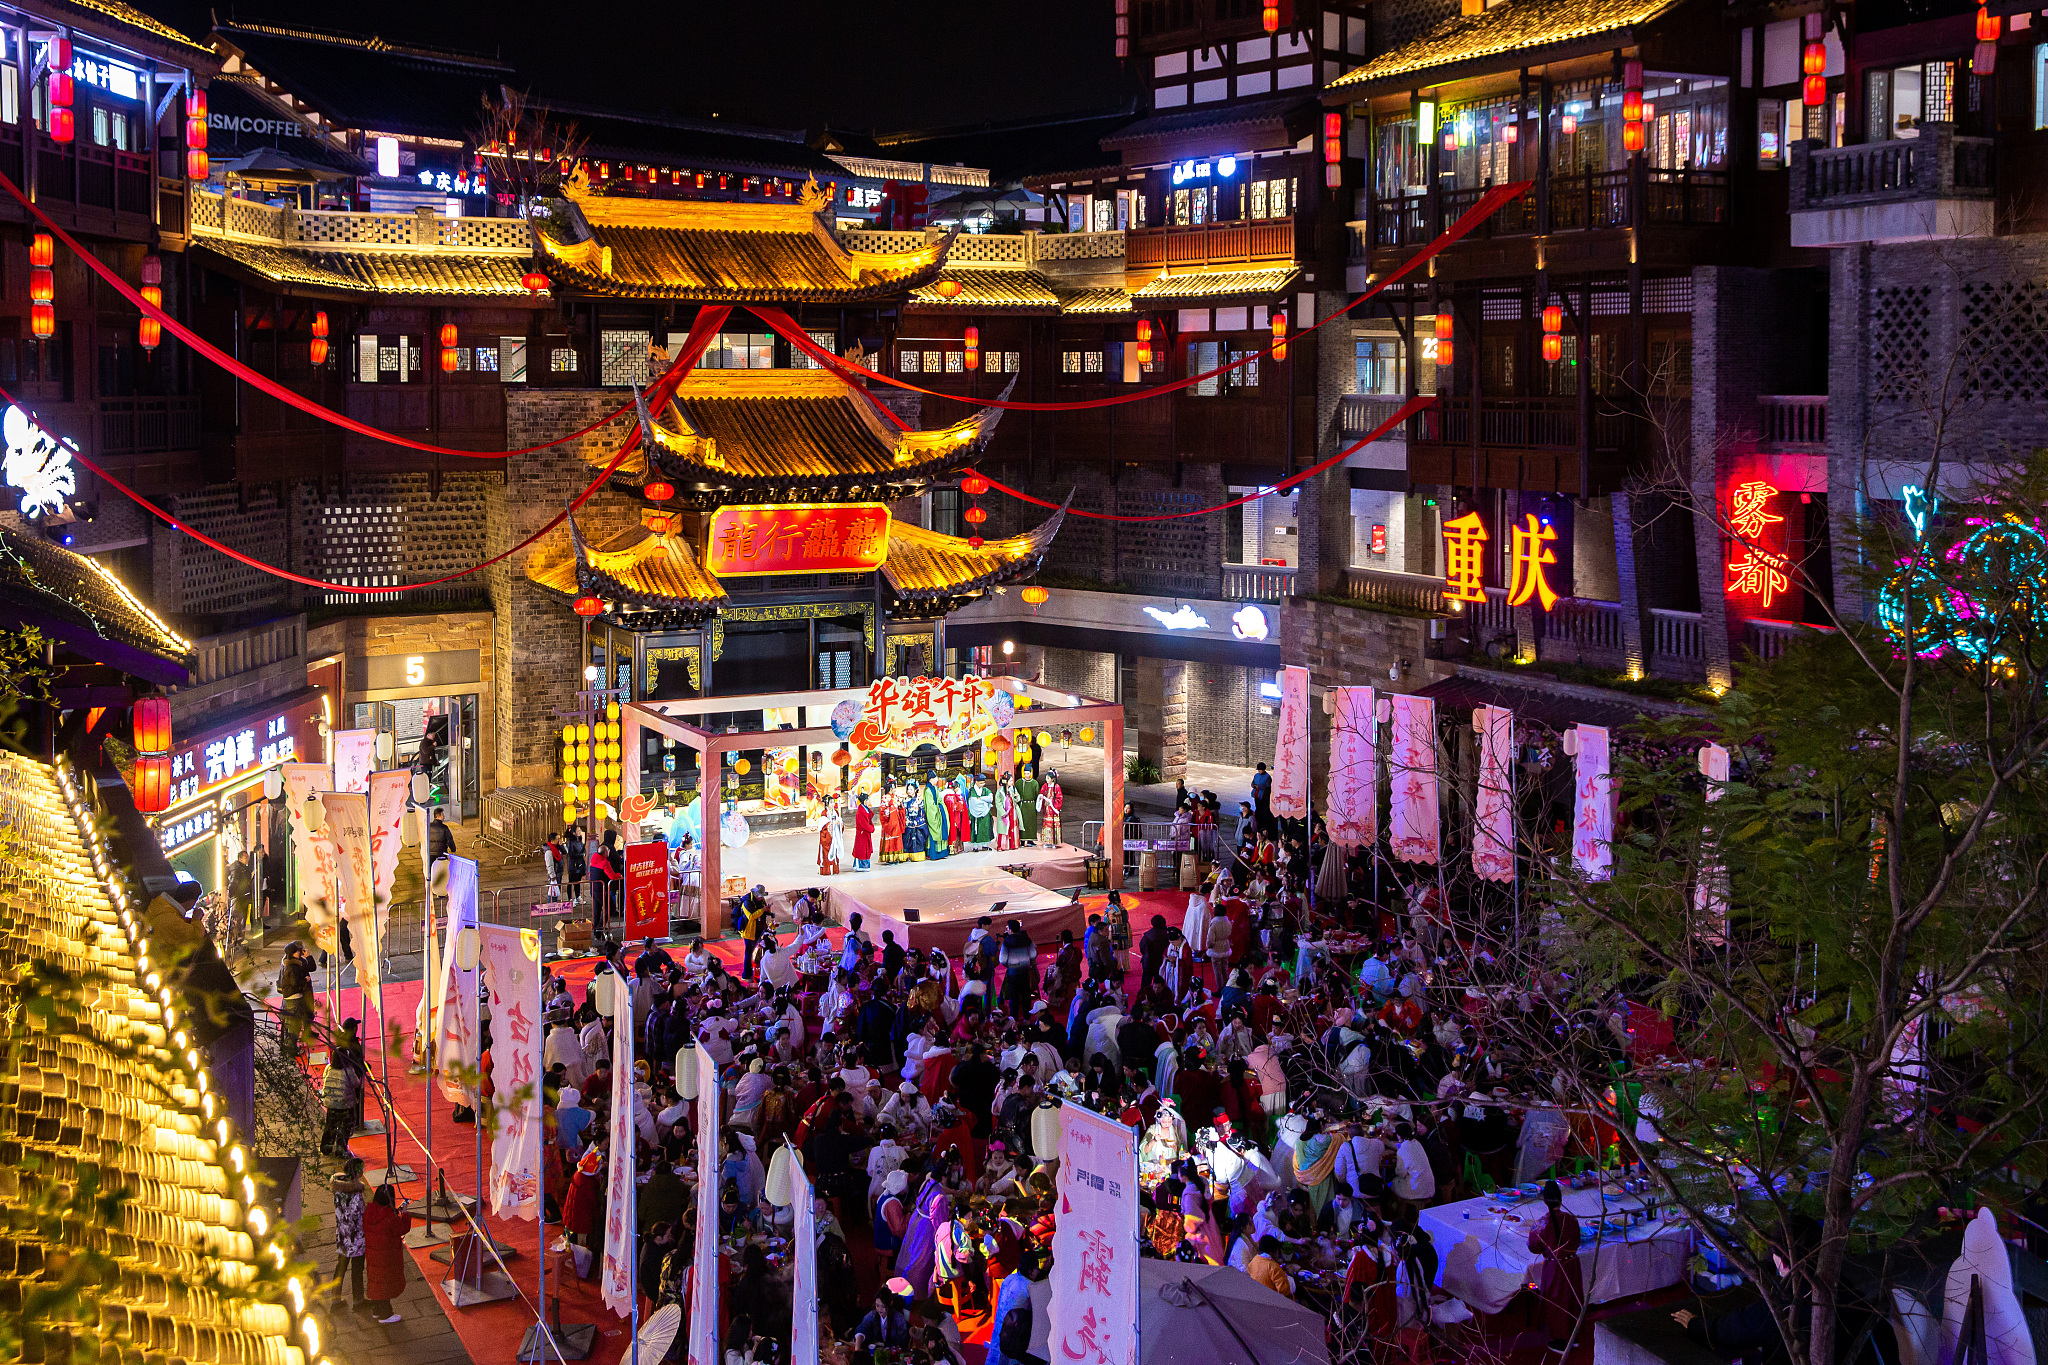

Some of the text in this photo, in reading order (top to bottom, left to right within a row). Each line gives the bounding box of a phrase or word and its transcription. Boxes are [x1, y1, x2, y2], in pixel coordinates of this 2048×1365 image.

[208, 112, 302, 138] ISMCOFFEE
[718, 516, 878, 562] 龍行龘龘
[1441, 511, 1559, 612] 重庆
[1728, 481, 1787, 608] 雾都
[406, 656, 424, 685] 5
